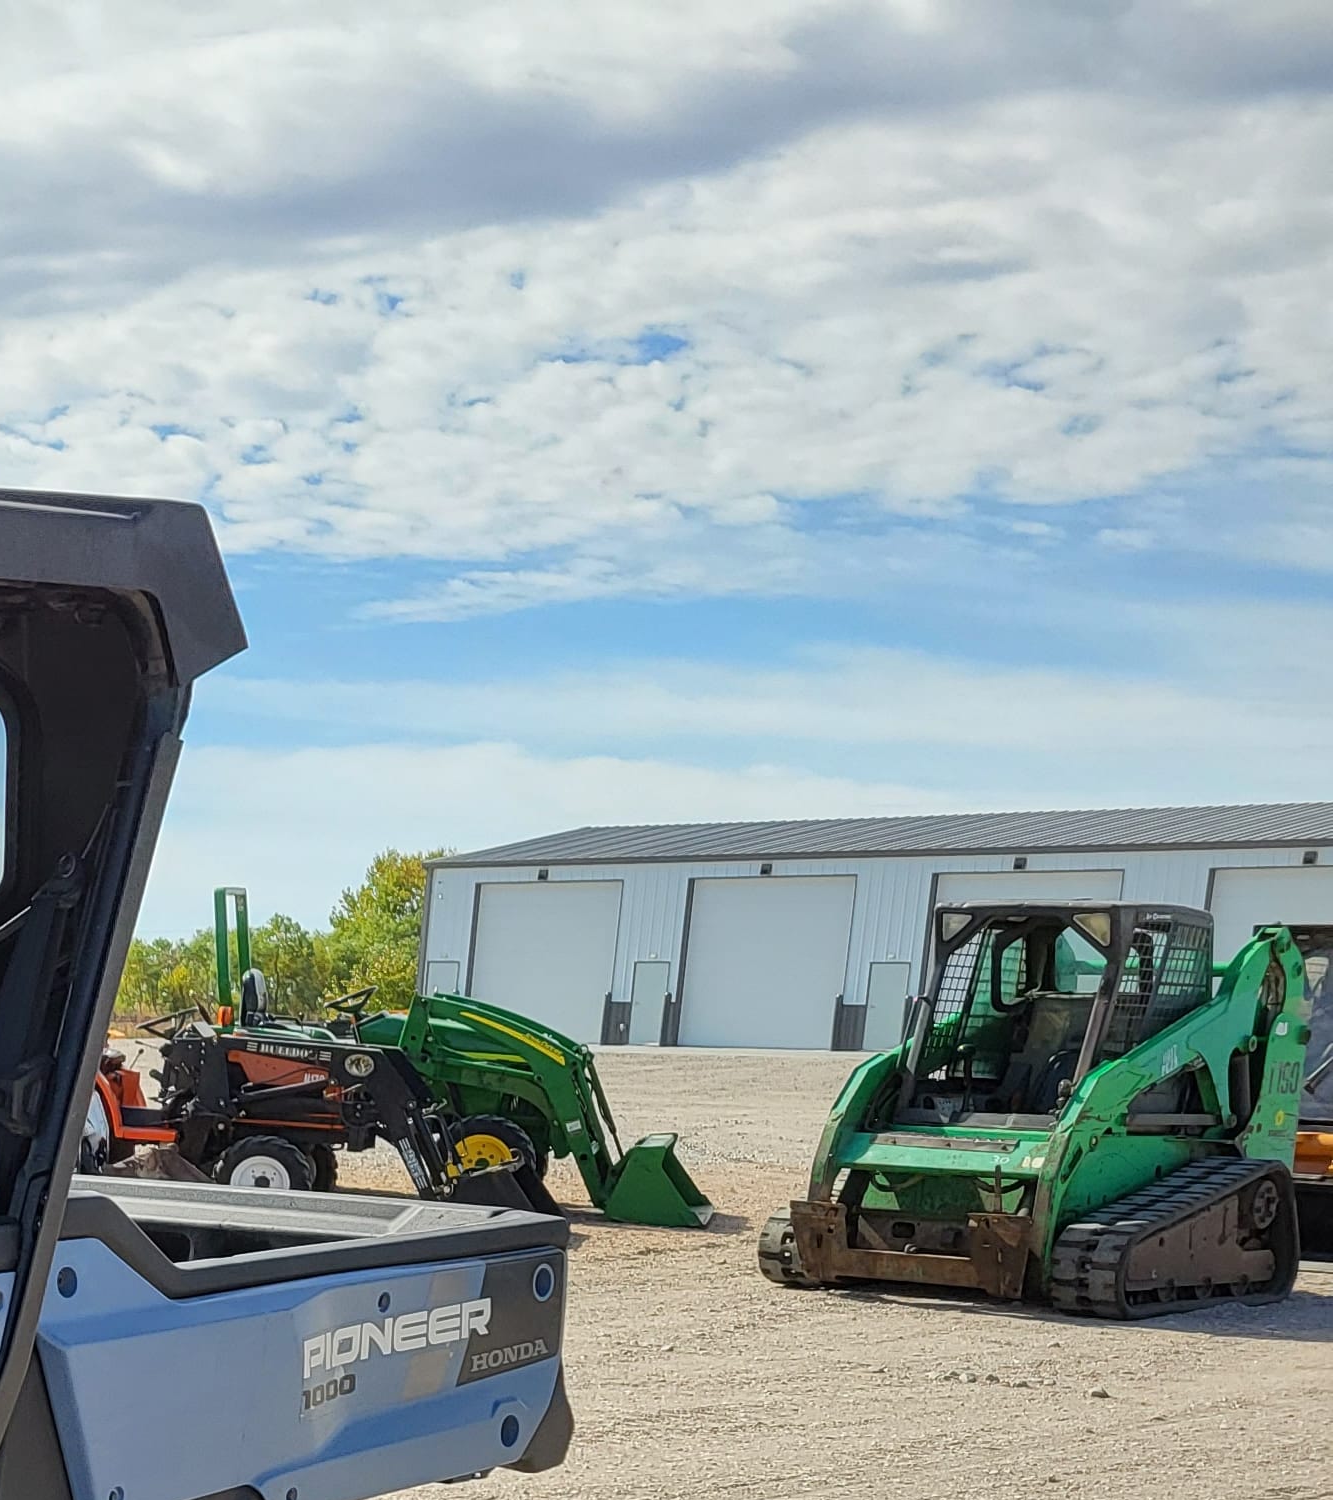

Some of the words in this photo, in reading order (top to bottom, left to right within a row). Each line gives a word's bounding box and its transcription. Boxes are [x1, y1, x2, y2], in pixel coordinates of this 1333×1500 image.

[303, 1297, 491, 1380] PIONEER
[470, 1339, 548, 1373] HONDA
[301, 1373, 356, 1411] 1000
